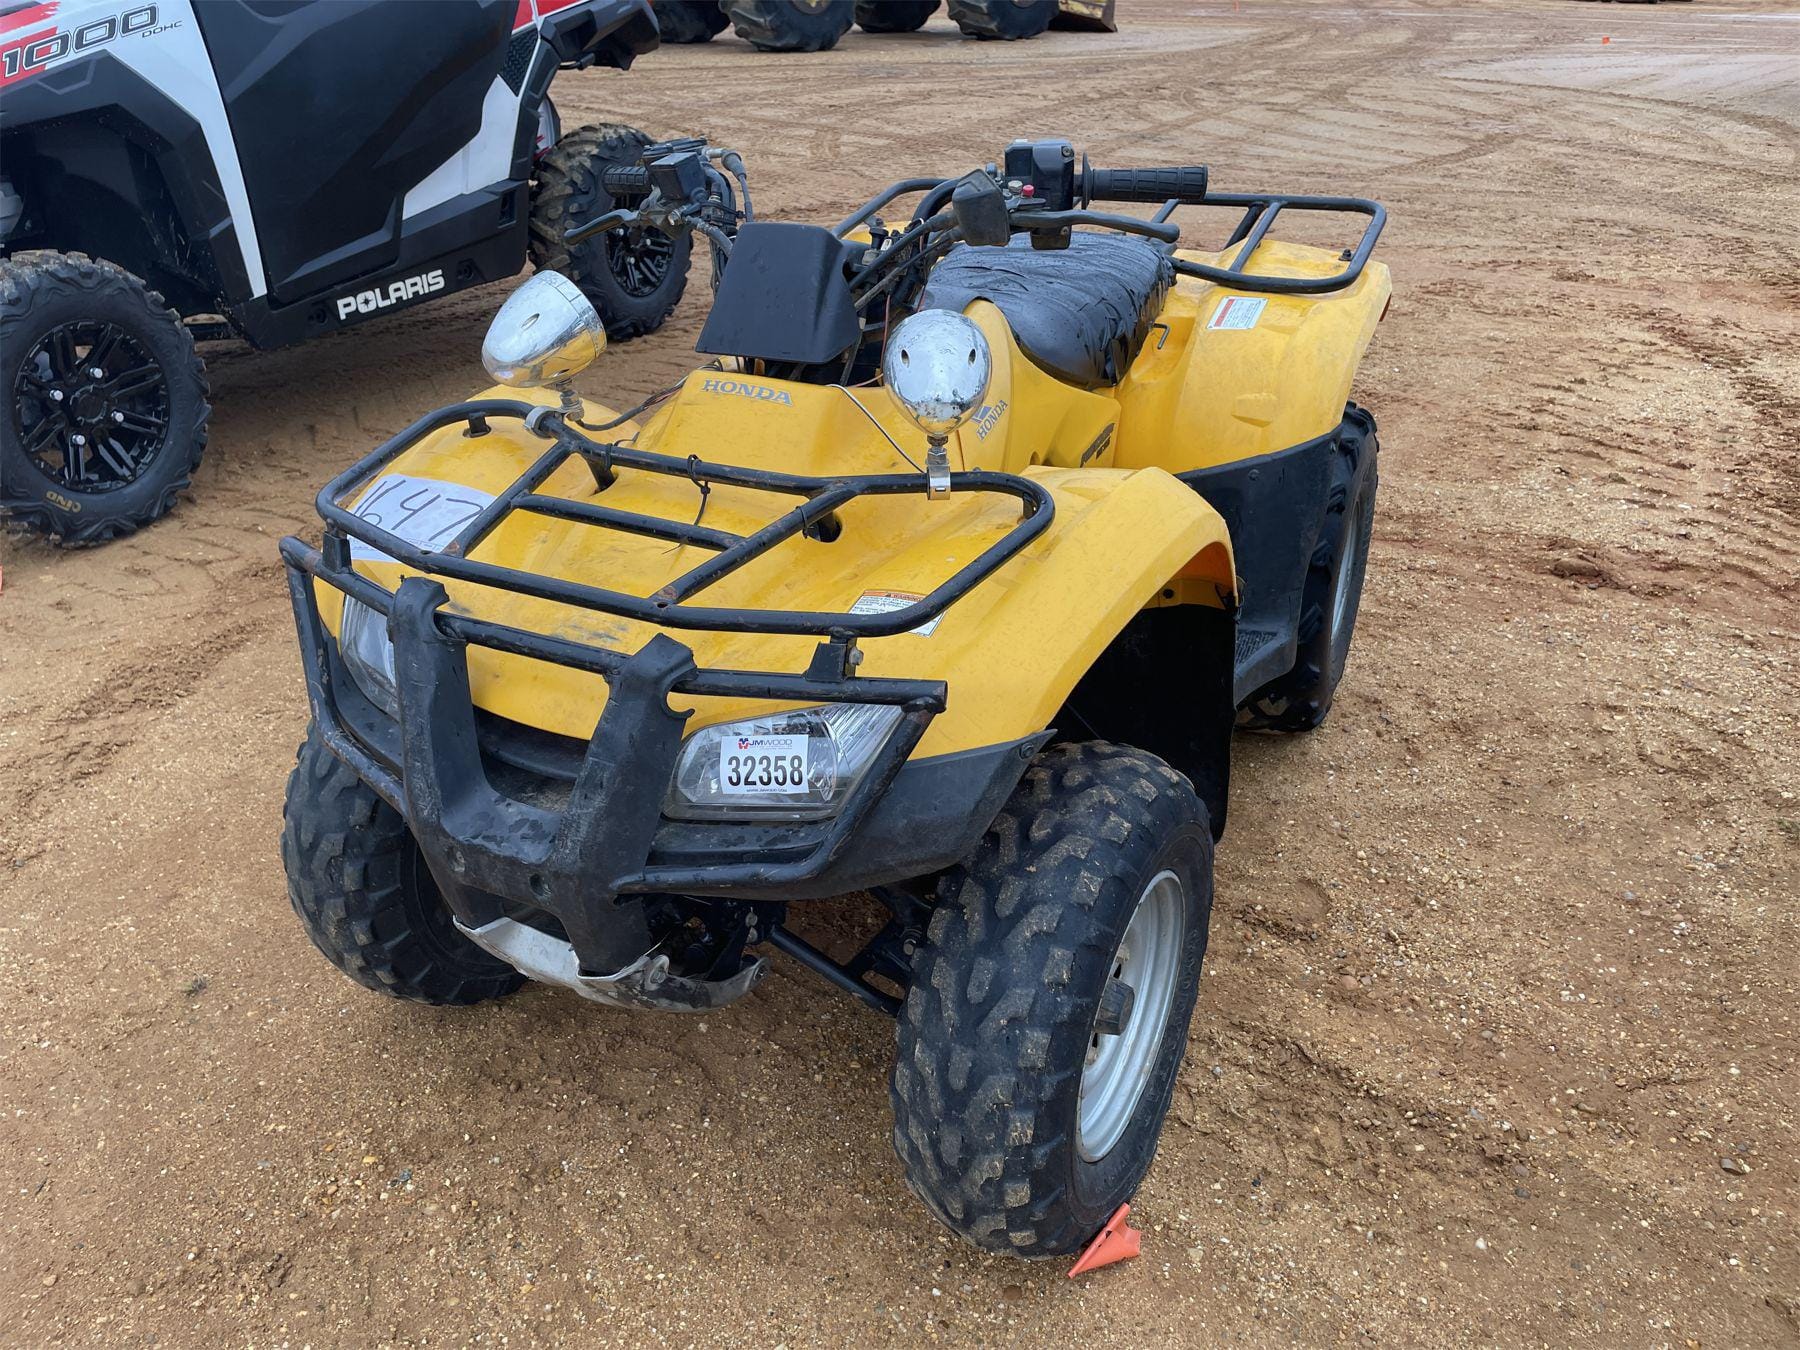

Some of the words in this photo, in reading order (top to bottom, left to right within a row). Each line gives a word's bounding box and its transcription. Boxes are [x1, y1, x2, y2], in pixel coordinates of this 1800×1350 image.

[3, 3, 159, 77] 1000
[142, 21, 183, 38] DOHC
[337, 269, 445, 320] POLARIS
[702, 379, 793, 406] HONDA
[976, 400, 1009, 440] HONDA
[727, 755, 803, 787] 32358
